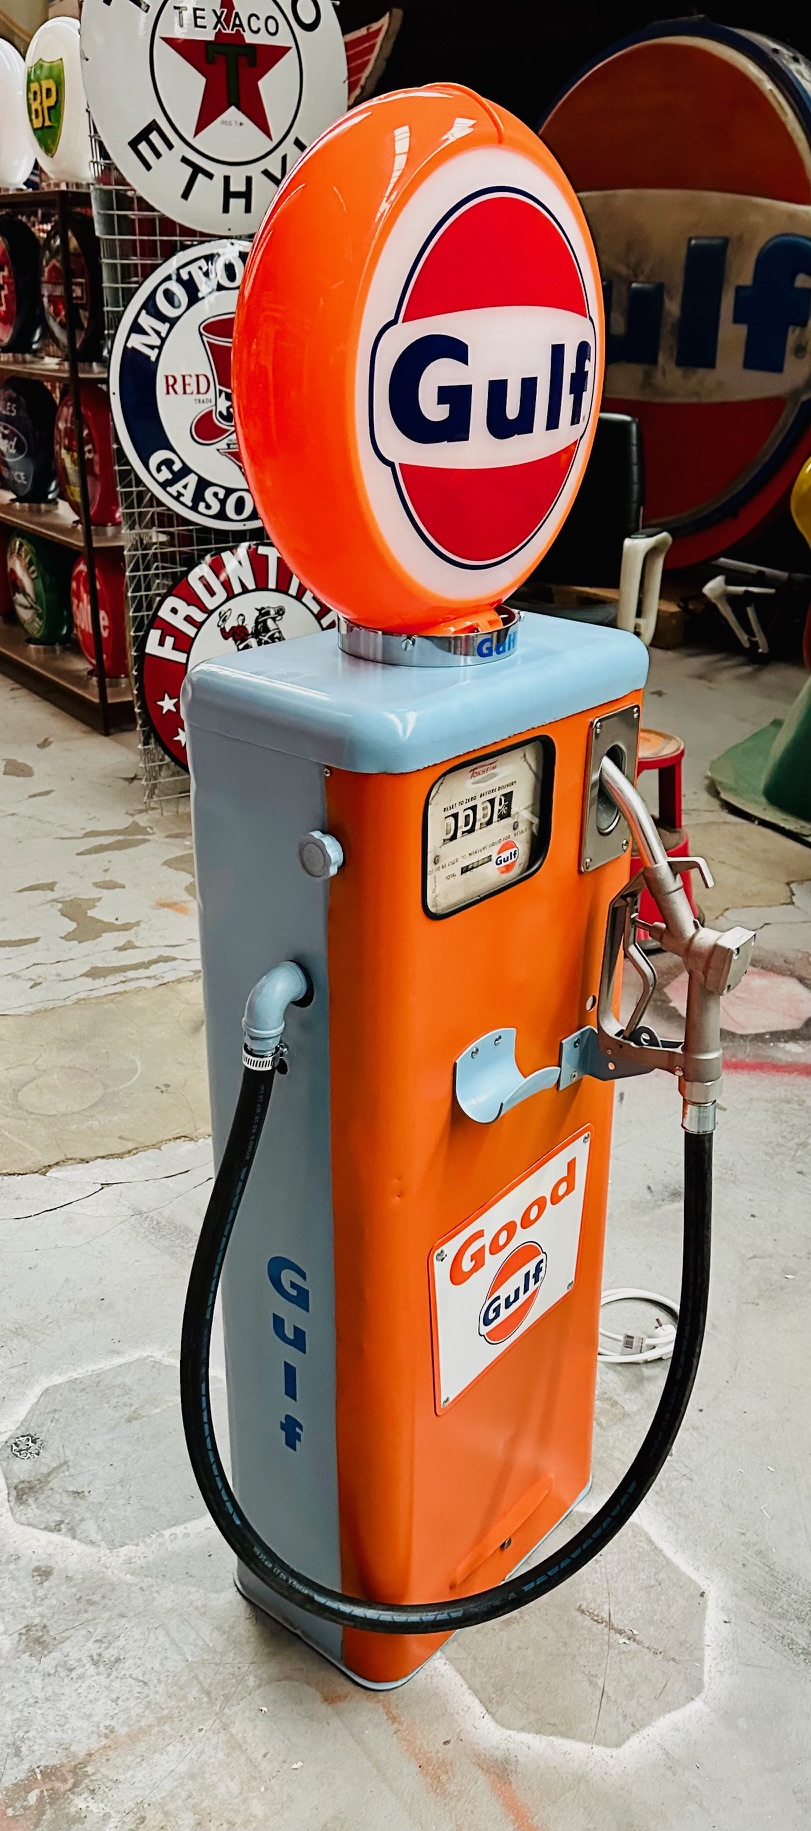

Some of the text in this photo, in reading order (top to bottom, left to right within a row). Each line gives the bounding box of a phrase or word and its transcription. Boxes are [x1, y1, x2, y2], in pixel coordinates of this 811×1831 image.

[173, 6, 280, 36] TEXACO
[29, 79, 57, 128] BP
[126, 252, 246, 362] MOTO
[602, 233, 811, 373] ulf
[163, 373, 211, 395] RED
[388, 333, 592, 445] Gulf
[148, 449, 255, 520] GASO
[476, 631, 517, 658] Gulf
[443, 803, 457, 813] RESET
[465, 795, 477, 804] ZERO
[480, 787, 497, 799] BEFORE
[495, 850, 518, 866] Gulf
[449, 1156, 577, 1286] Good
[482, 1258, 544, 1328] Gulf
[267, 1256, 310, 1452] Gulf
